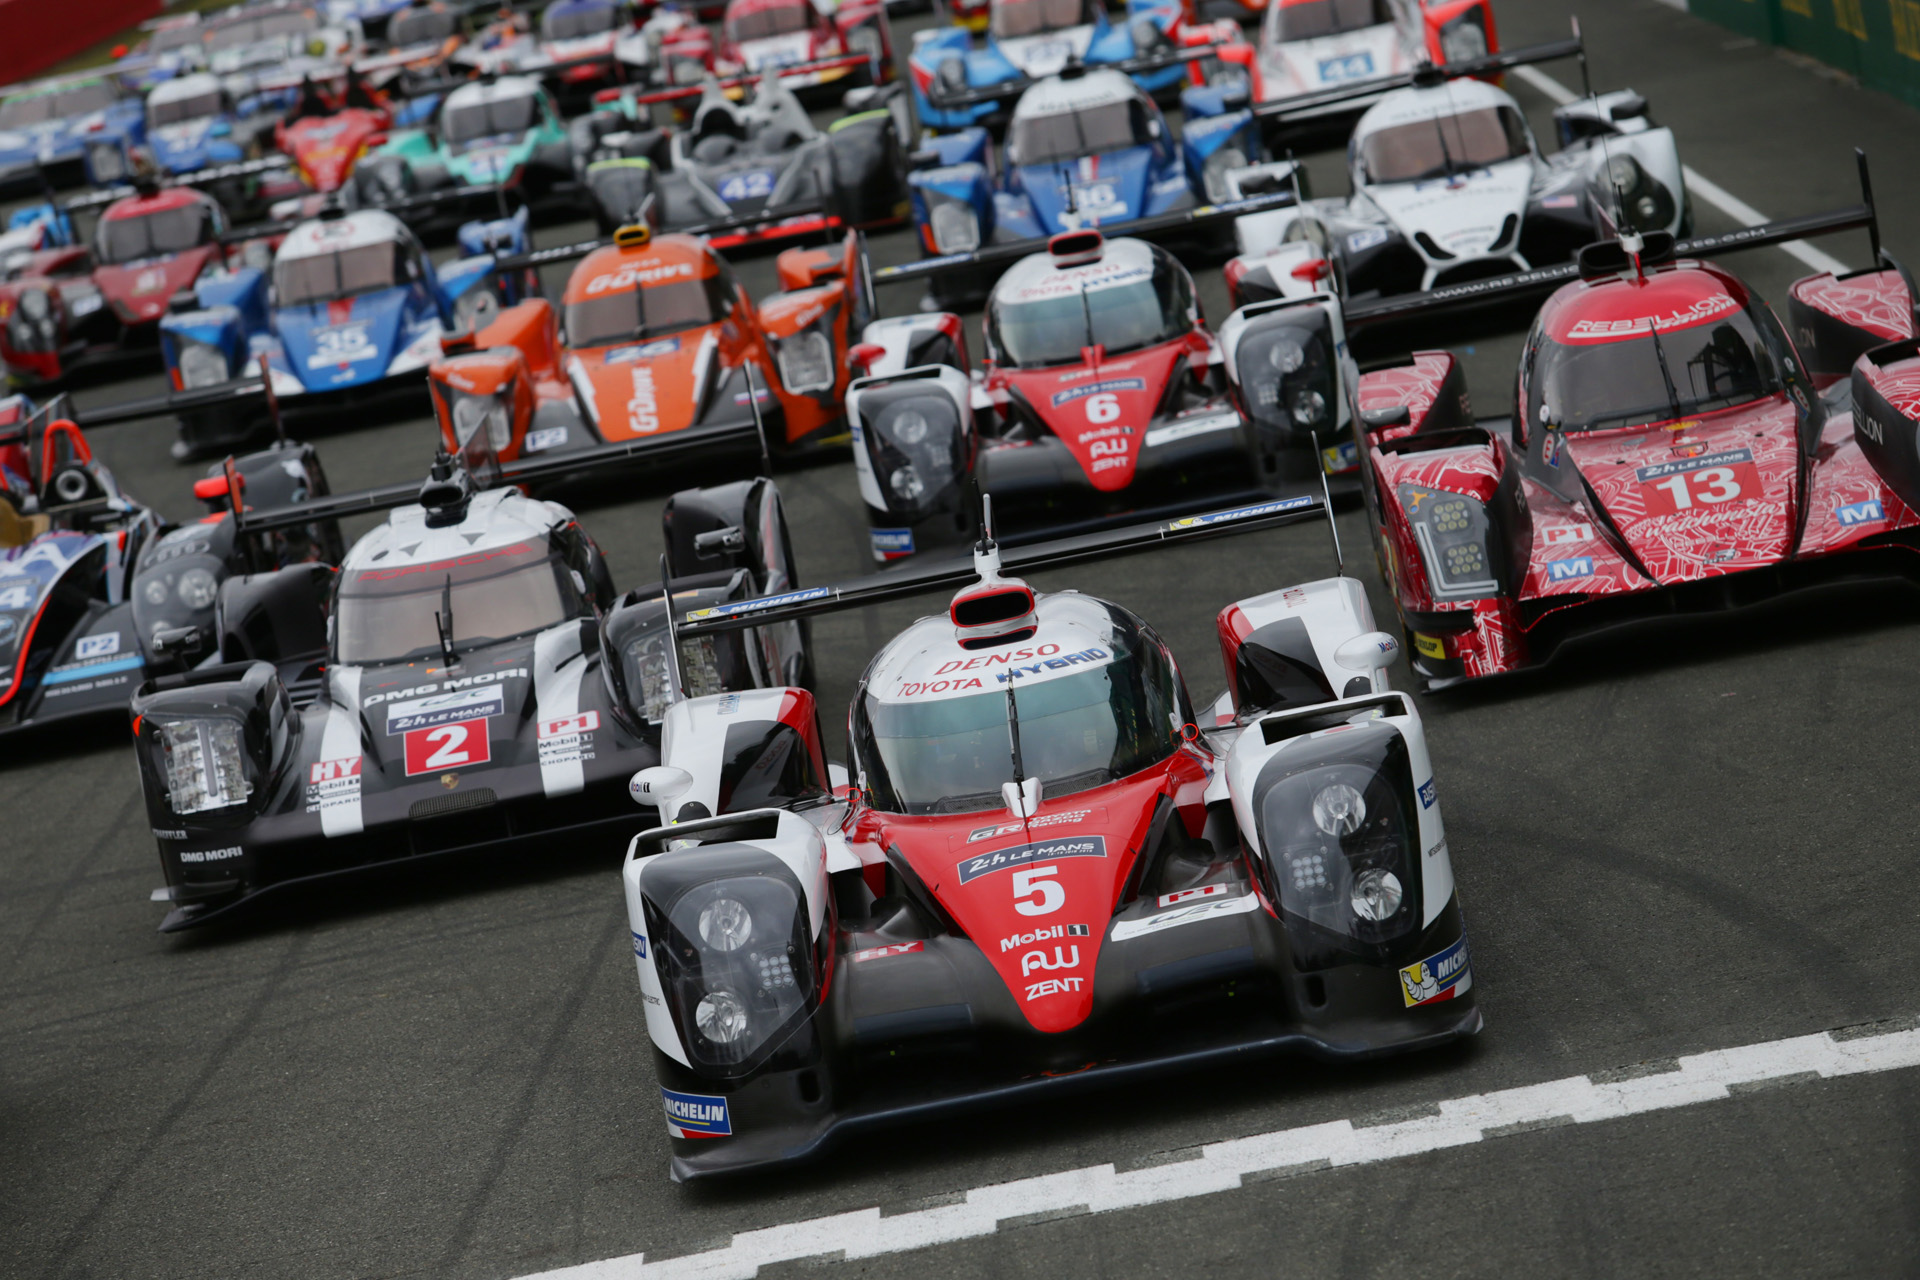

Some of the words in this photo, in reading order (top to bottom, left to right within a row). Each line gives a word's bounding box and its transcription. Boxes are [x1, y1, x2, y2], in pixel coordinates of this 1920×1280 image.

[721, 173, 770, 199] 42
[1572, 292, 1730, 332] REBELLION
[1086, 394, 1120, 424] 6
[1078, 427, 1119, 443] Mobil
[1092, 456, 1129, 473] ZENT
[1700, 452, 1744, 466] MANS
[1656, 467, 1741, 510] 13
[1213, 499, 1309, 522] MICHELIN
[1841, 503, 1879, 523] M
[1547, 527, 1584, 542] P1
[358, 543, 532, 582] PORSCHE
[1553, 560, 1588, 578] M
[730, 590, 825, 613] MICHELIN
[83, 638, 114, 654] P2
[934, 643, 1060, 676] DENSO
[897, 678, 983, 697] TOYOTA
[996, 648, 1108, 683] HYBRID
[364, 684, 437, 709] DMG
[444, 668, 528, 690] MORI
[429, 711, 448, 723] LE
[450, 704, 495, 719] MANS
[550, 716, 587, 734] P1
[425, 725, 470, 768] 2
[539, 737, 577, 749] Mobil
[540, 752, 595, 766] CHOPARD
[311, 758, 359, 783] HY
[306, 780, 345, 794] Mobil
[970, 825, 1021, 842] GR
[1029, 810, 1091, 822] TOYOTA
[1027, 818, 1083, 829] Racing
[180, 852, 204, 862] DMG
[205, 846, 243, 861] MORI
[1010, 850, 1034, 861] LE
[1037, 843, 1095, 856] MANS
[1012, 865, 1065, 916] 5
[1169, 886, 1214, 902] P1
[1000, 925, 1063, 952] Mobil
[860, 942, 918, 960] HY
[1025, 977, 1084, 1001] ZENT
[664, 1097, 724, 1121] MICHELIN
